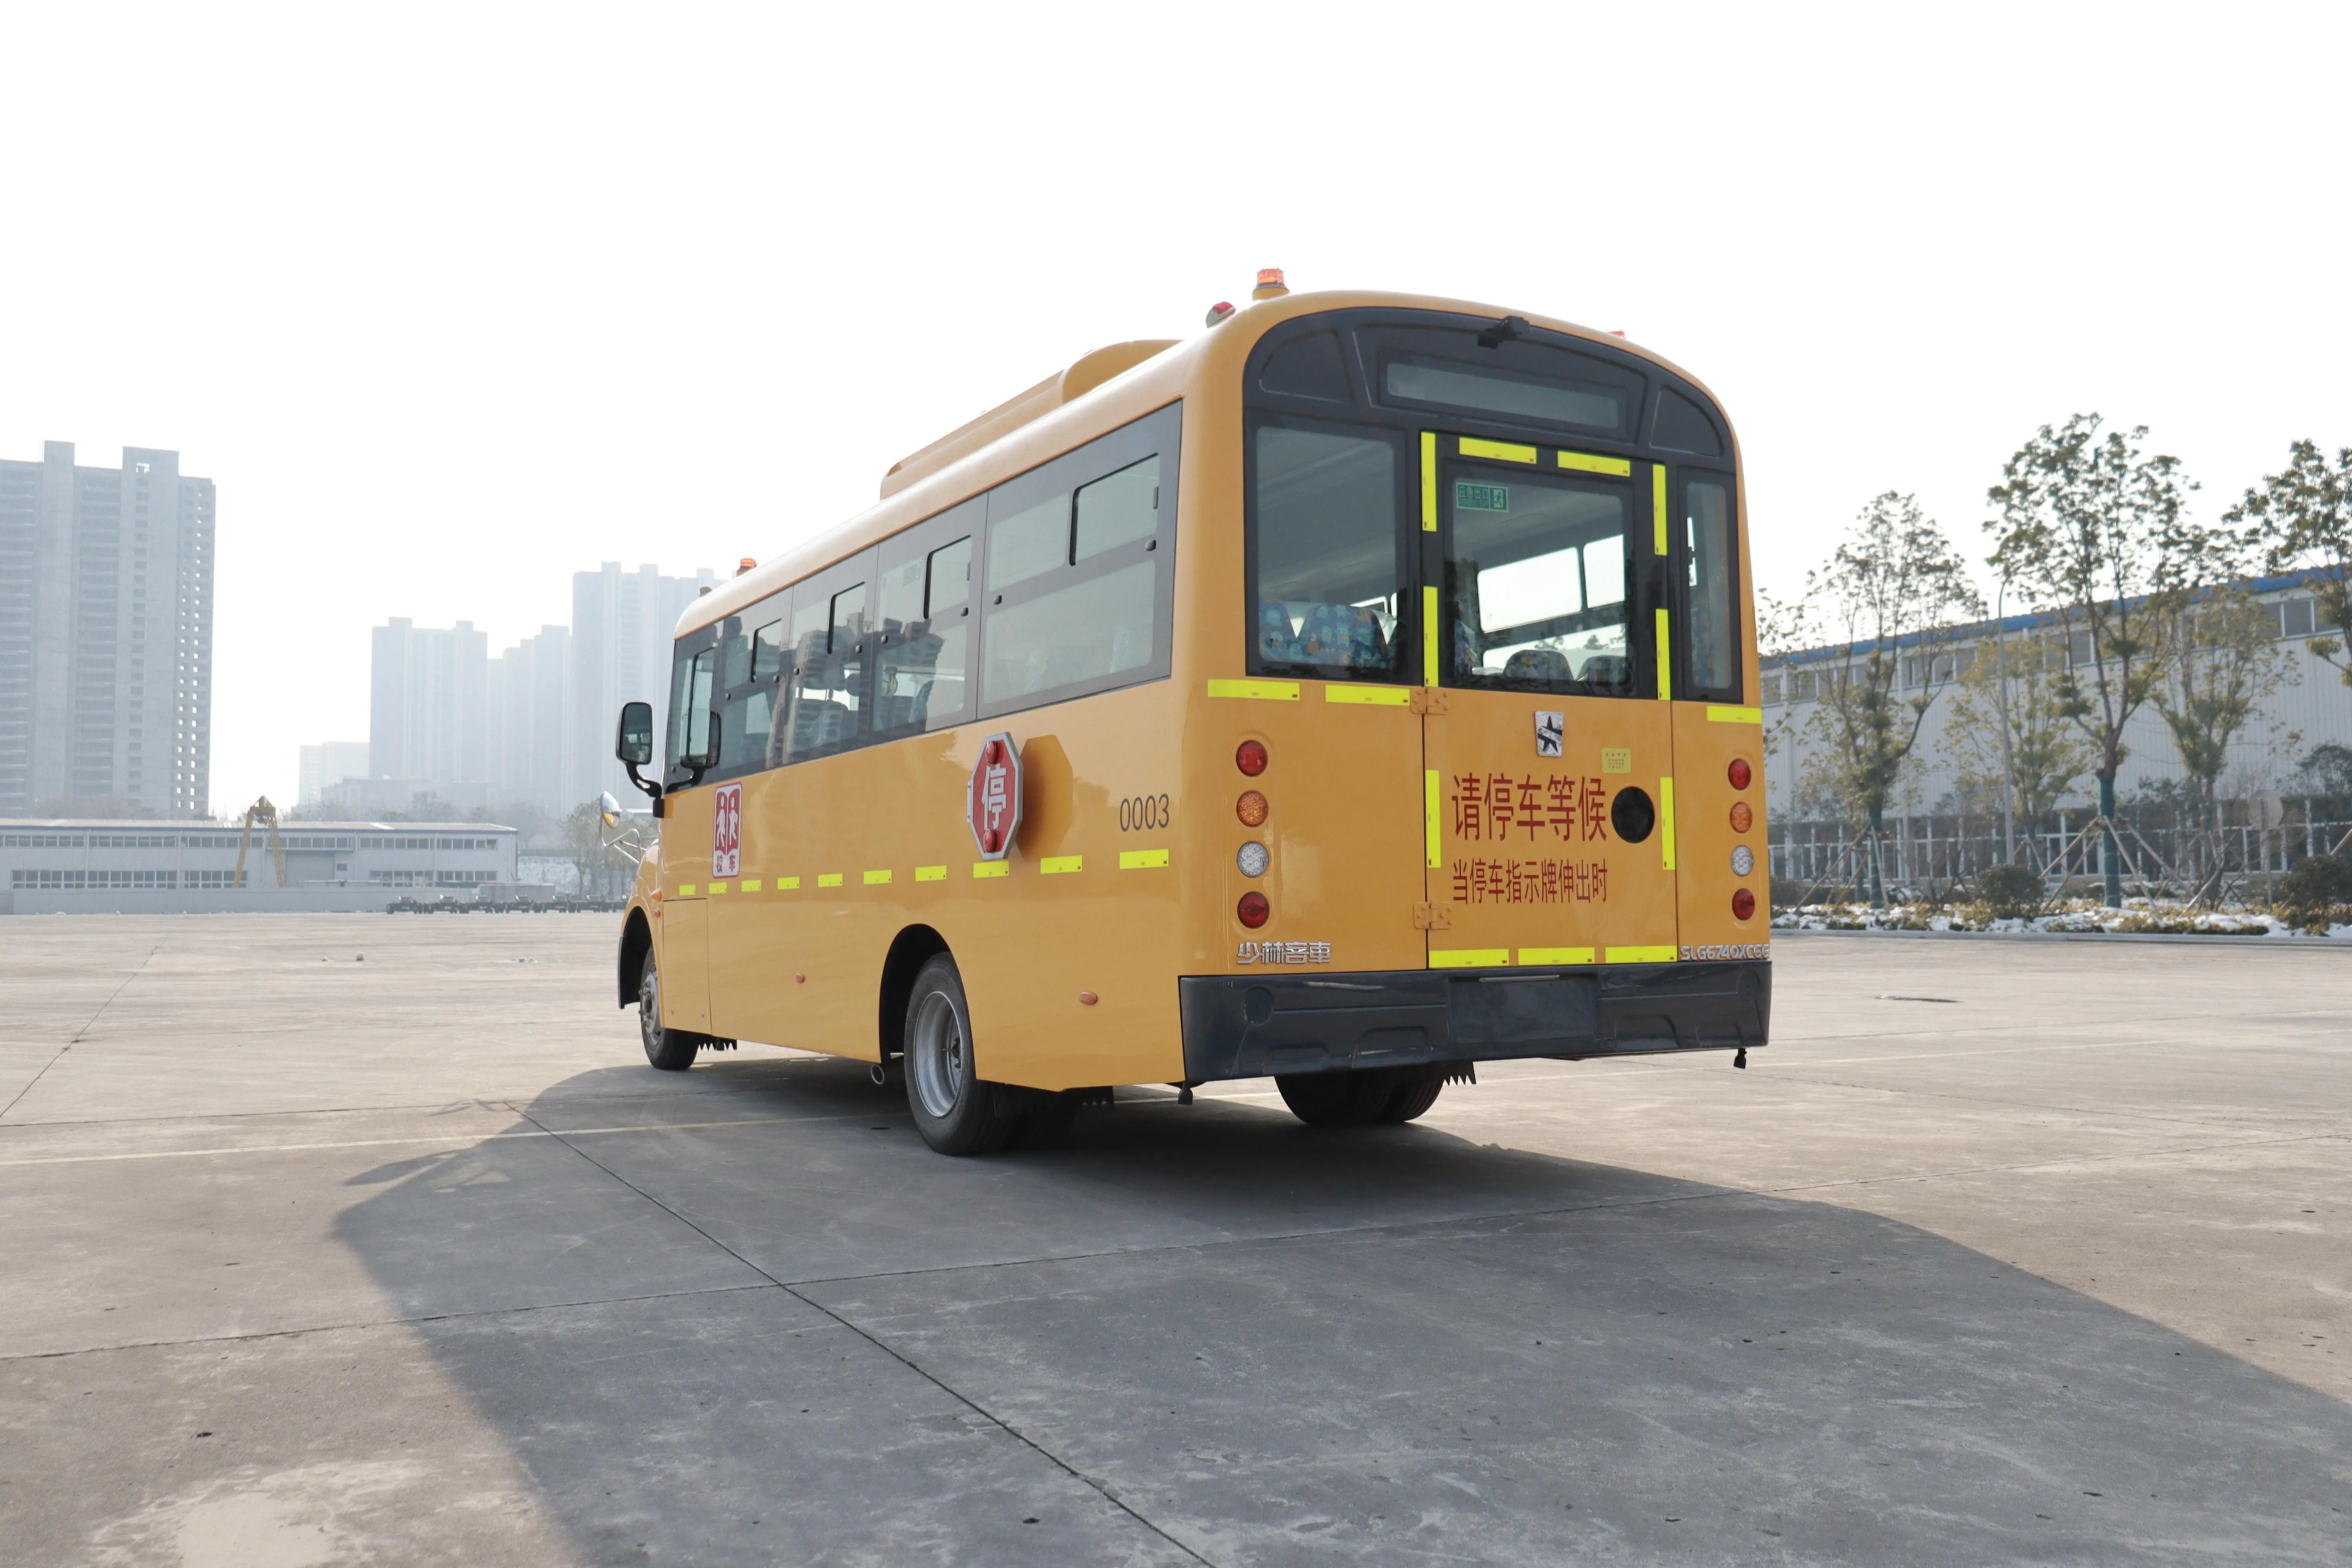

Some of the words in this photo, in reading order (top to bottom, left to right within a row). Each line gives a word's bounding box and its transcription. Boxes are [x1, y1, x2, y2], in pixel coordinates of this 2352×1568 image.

[1459, 486, 1488, 499] 应急出口
[982, 763, 1006, 830] 停
[1120, 794, 1169, 832] 0003
[1452, 772, 1606, 842] 请停车等候
[1453, 858, 1607, 904] 当停车指示牌伸出时
